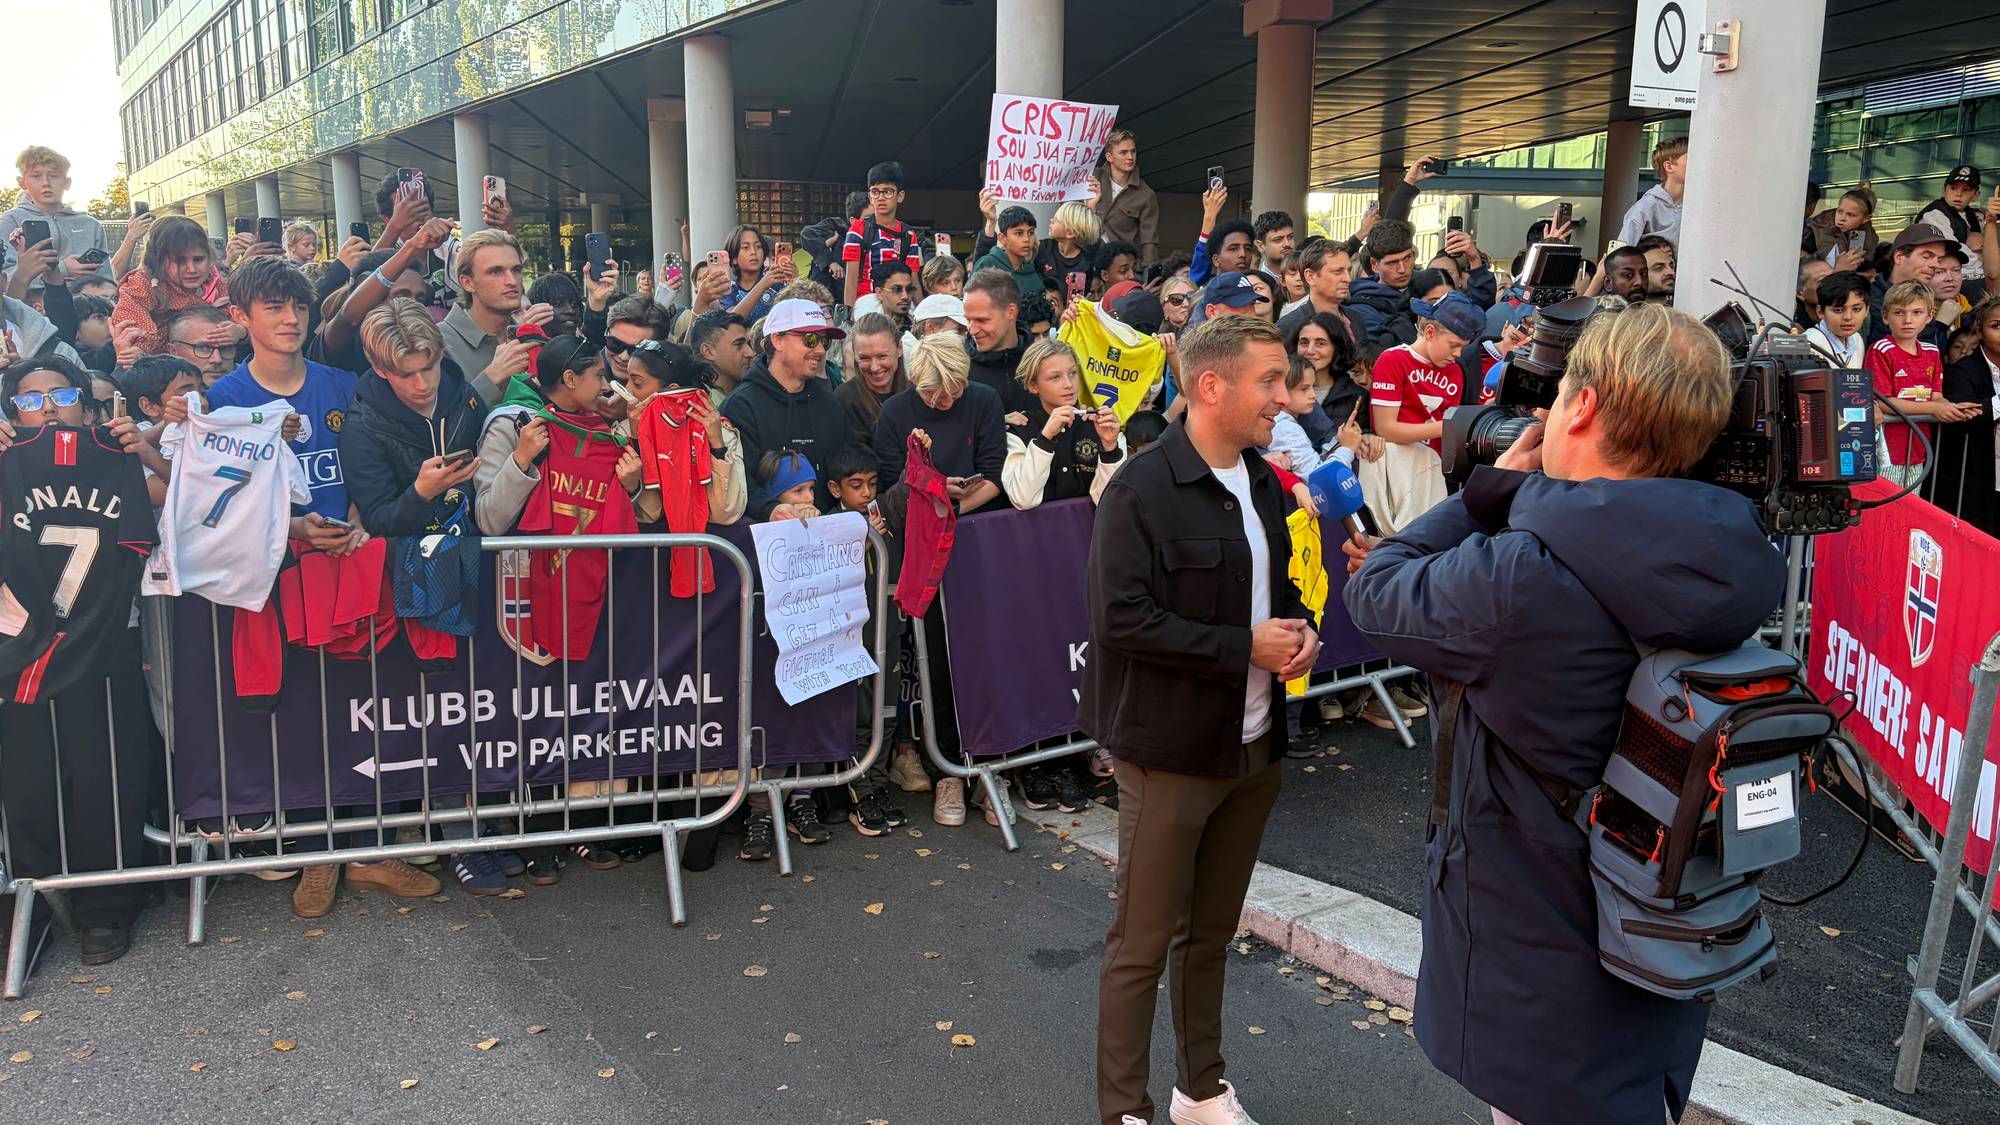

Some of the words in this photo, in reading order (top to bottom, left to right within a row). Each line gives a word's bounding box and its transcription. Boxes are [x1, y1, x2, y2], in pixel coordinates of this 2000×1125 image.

[1002, 100, 1116, 145] CRISTIANO
[987, 159, 1000, 181] 11
[997, 134, 1027, 160] SOU
[1032, 140, 1060, 163] SUA
[1080, 146, 1102, 166] DE
[1007, 185, 1028, 200] POR
[1086, 356, 1139, 383] RONALDO
[1407, 368, 1458, 396] ONALDO
[299, 452, 338, 486] IG
[1080, 464, 1095, 472] Tezo
[201, 465, 253, 529] 7
[551, 500, 598, 576] 7
[38, 524, 100, 619] 7
[766, 537, 865, 582] CRISTIANO
[777, 586, 819, 617] CAN
[785, 623, 818, 651] GET
[829, 607, 841, 634] A
[782, 643, 835, 683] PICTURE
[793, 670, 832, 694] WITH
[835, 654, 877, 681] YOU?
[349, 689, 497, 732] KLUBB
[511, 673, 724, 721] ULLEVAAL
[458, 741, 518, 771] VIP
[529, 721, 724, 766] PARKERING
[1747, 787, 1777, 802] ENG-04
